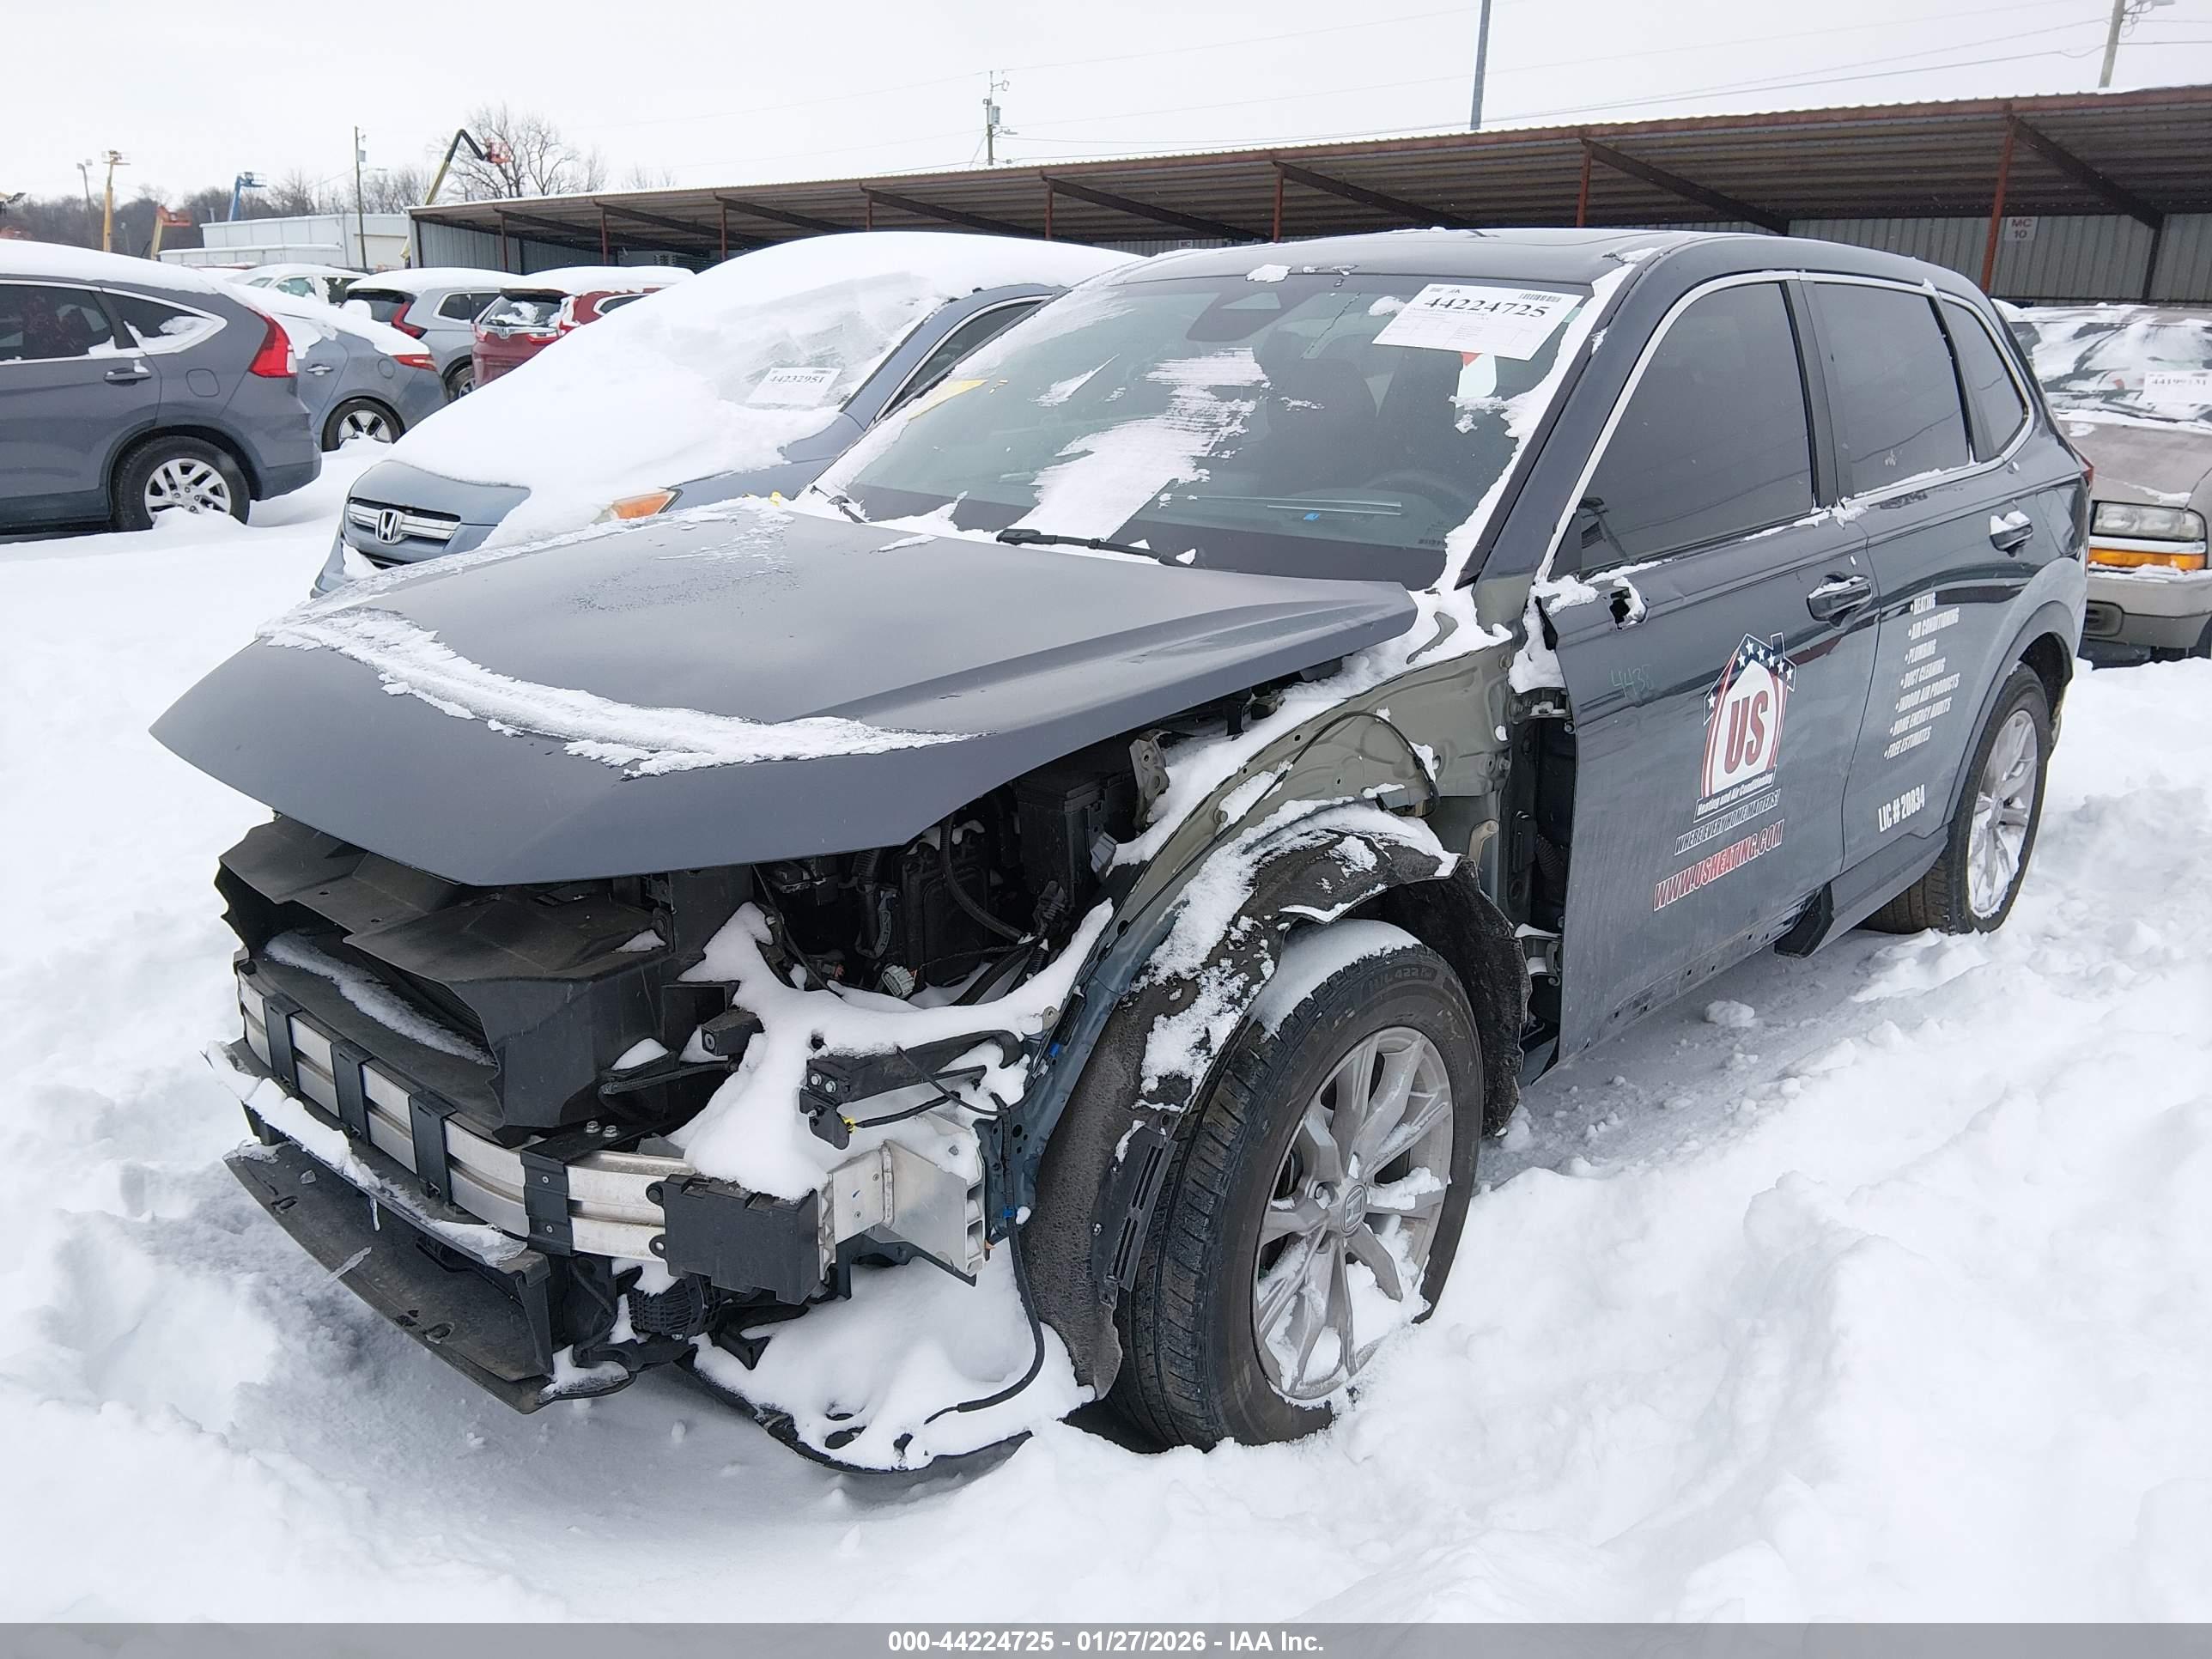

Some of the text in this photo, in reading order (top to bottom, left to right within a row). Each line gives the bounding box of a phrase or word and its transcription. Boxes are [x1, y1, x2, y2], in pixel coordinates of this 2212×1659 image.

[2011, 218, 2033, 227] MC
[2014, 229, 2027, 239] 10
[1424, 297, 1551, 318] 44224725
[1913, 591, 1936, 616] HEATING
[1911, 607, 1960, 641] AIR CONDITIONING
[1907, 638, 1937, 665] PLUMBING
[1903, 657, 1946, 689] DUCT CLEANING
[1918, 684, 1932, 703] AIR
[1929, 672, 1960, 699] PRODUCTS
[1724, 690, 1769, 775] US
[1909, 705, 1932, 729] ENERGY
[1887, 726, 1932, 760] FREE ESTIMATES
[1697, 773, 1774, 817] Heating and Air Conditioning
[1674, 825, 1705, 856] WHERE
[1701, 816, 1726, 843] EVERY
[1723, 805, 1747, 831] HOME
[1878, 803, 1892, 833] LIC
[1653, 818, 1785, 912] WWW.USHEATING.COM
